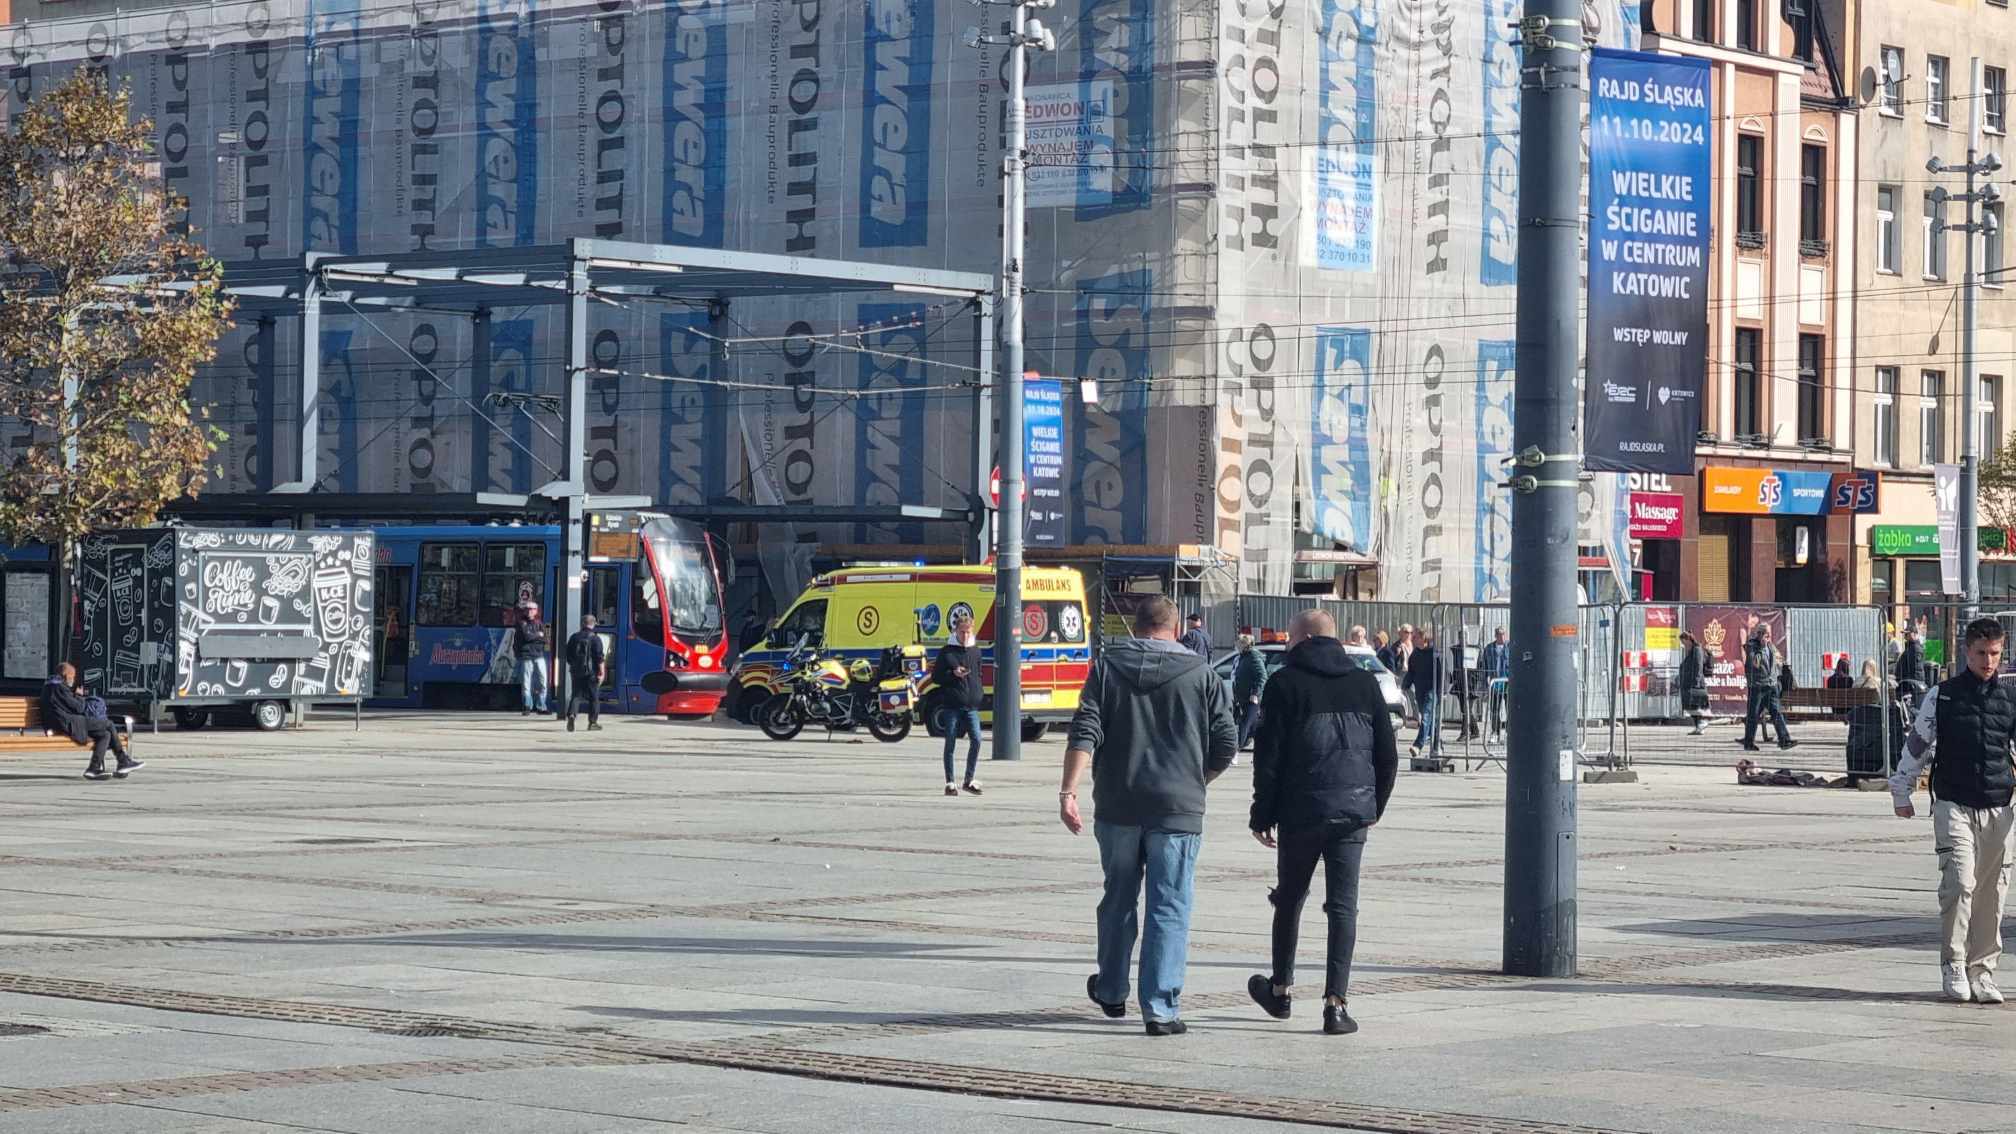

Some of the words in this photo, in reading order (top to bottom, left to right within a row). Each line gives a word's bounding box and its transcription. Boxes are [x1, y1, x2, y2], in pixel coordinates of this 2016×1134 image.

[1598, 77, 1640, 101] RAJD
[1644, 77, 1705, 111] ŚLĄSKA
[1601, 116, 1705, 145] 11.10.2024
[1612, 170, 1693, 201] WIELKIE
[1607, 199, 1697, 237] ŚCIGANIE
[1601, 239, 1618, 262] W
[1623, 240, 1701, 268] CENTRUM
[1613, 271, 1691, 299] KATOWIC
[1613, 327, 1651, 347] WSTĘP
[1652, 329, 1688, 346] WOLNY
[1033, 466, 1060, 478] KATOWIC
[1758, 476, 1782, 507] STS
[1835, 478, 1875, 509] STS
[1635, 502, 1679, 524] Massage
[204, 559, 256, 591] Coffee
[1025, 578, 1072, 592] AMBULANS
[207, 587, 256, 614] Time
